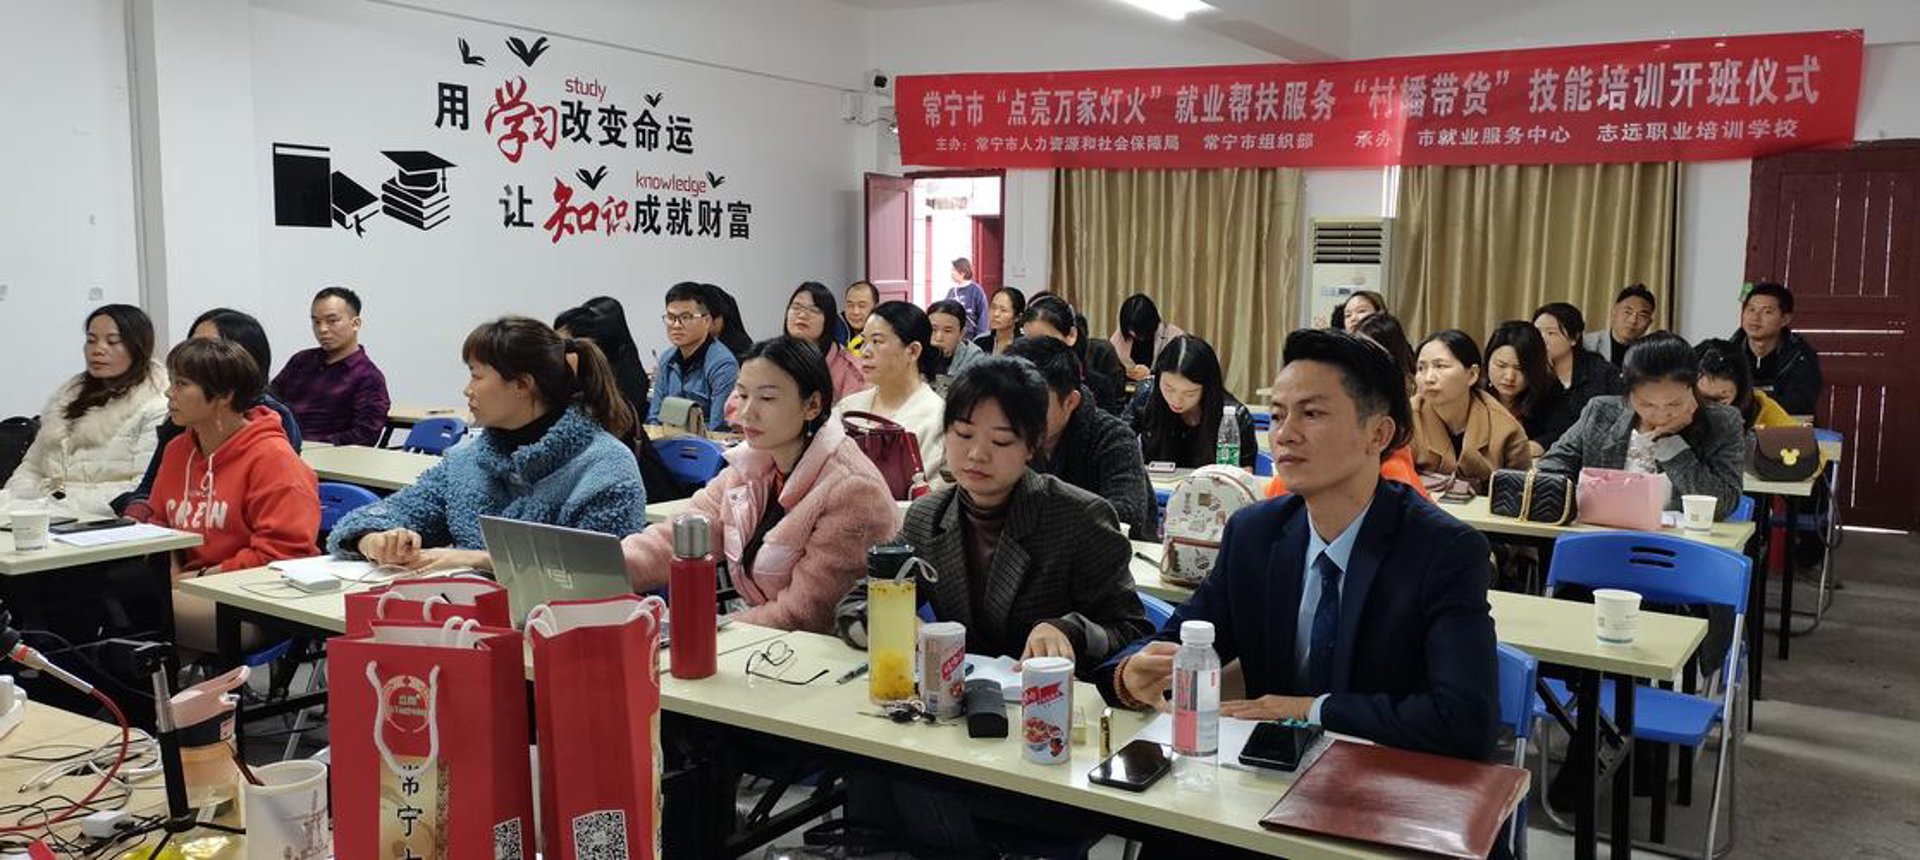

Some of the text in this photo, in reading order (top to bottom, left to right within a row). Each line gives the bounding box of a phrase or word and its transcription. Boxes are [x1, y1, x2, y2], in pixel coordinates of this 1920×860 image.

[565, 76, 606, 102] study
[435, 76, 694, 163] 用学习改变命运
[1203, 132, 1314, 151] 常宁市组织部
[1597, 117, 1798, 142] 志远职业培训学校
[636, 170, 706, 197] knowledge
[499, 176, 752, 243] 让知识成就财富
[397, 764, 423, 860] 常宁
